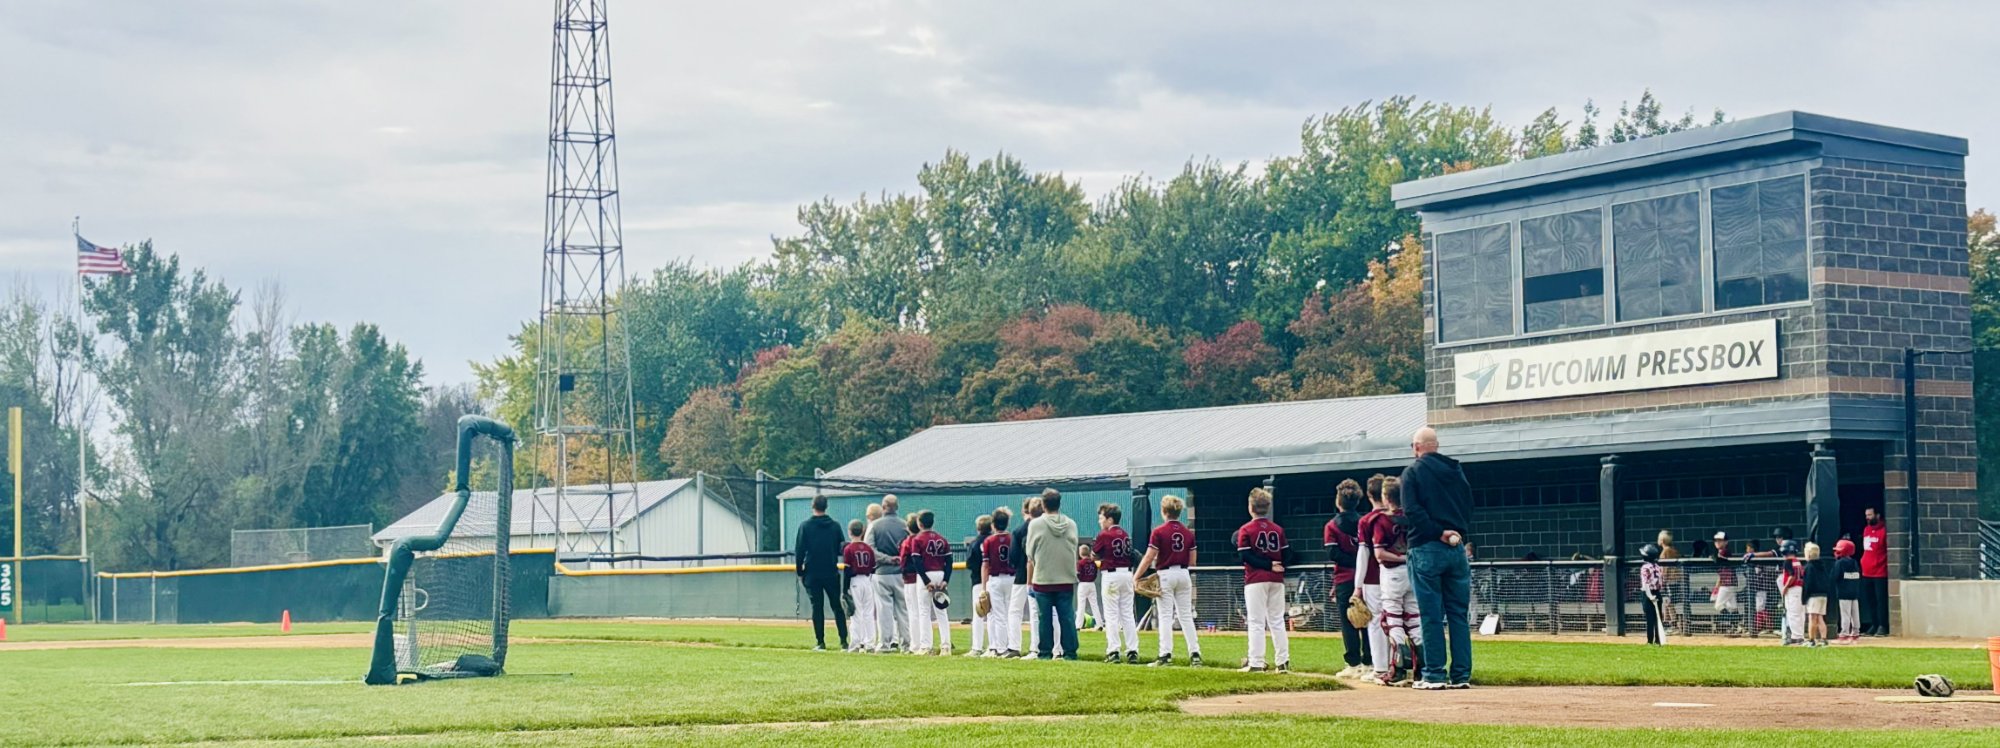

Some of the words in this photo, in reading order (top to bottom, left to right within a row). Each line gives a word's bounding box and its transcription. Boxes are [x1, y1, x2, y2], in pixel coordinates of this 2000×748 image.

[1506, 354, 1627, 391] BEVCOMM
[1637, 339, 1765, 378] PRESSBOX
[926, 539, 945, 556] 42
[1111, 536, 1132, 558] 38
[1171, 532, 1184, 552] 3
[1255, 531, 1279, 553] 49
[855, 551, 870, 567] 10
[998, 544, 1009, 562] 9
